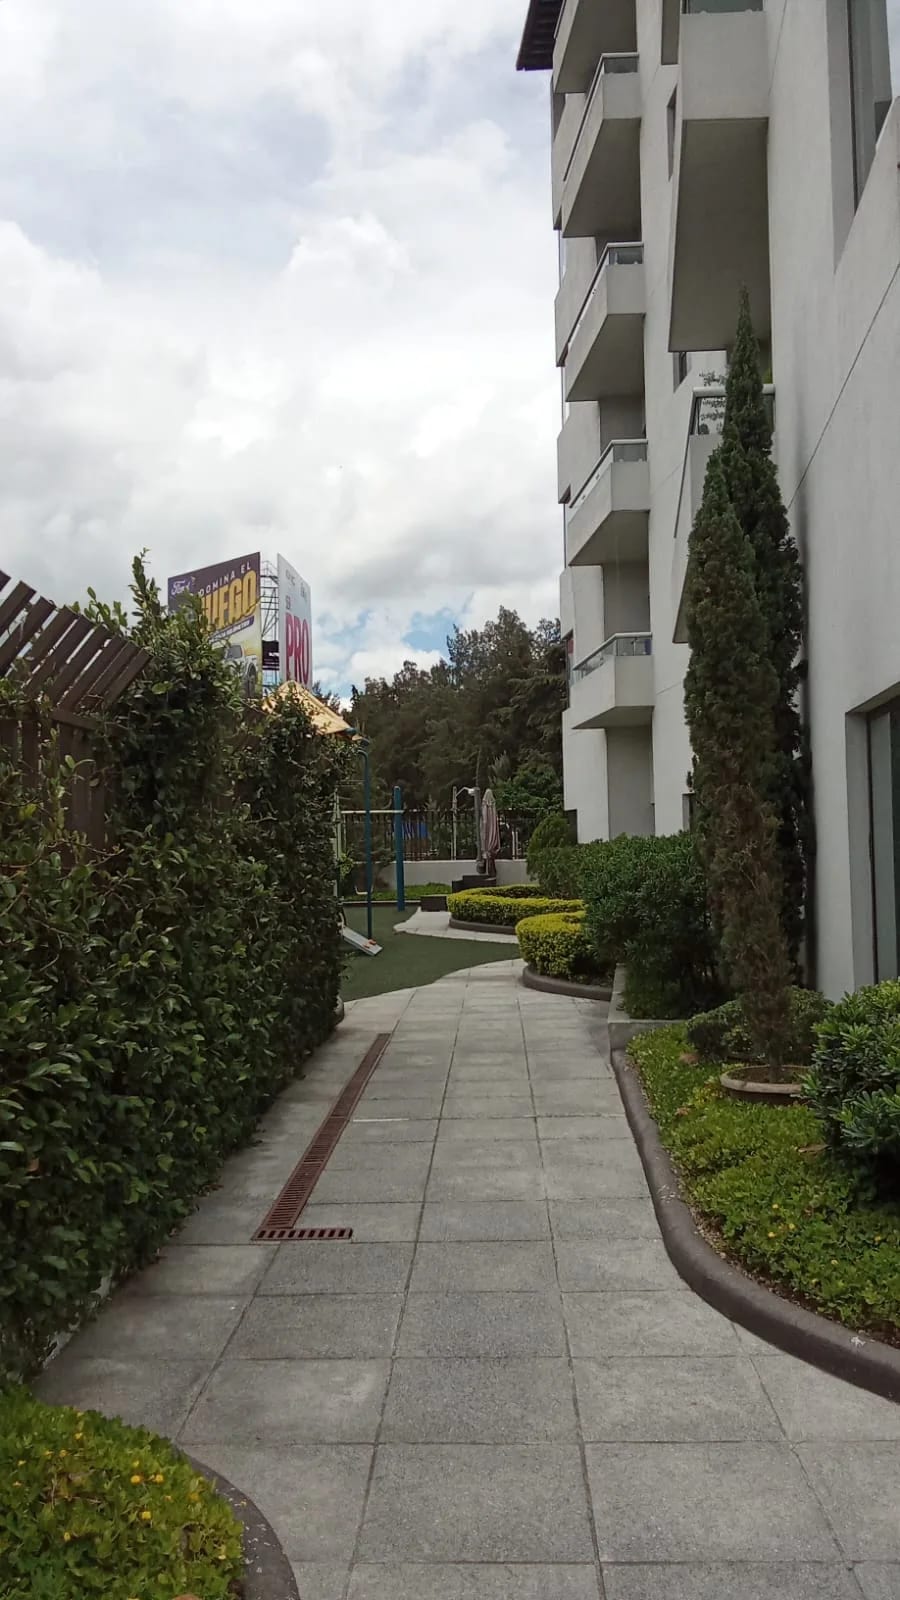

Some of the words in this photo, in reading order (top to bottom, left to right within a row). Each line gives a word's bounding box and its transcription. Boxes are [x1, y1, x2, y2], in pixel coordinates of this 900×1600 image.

[200, 570, 236, 598] DOMINA
[241, 561, 251, 574] EL
[285, 612, 310, 685] PRO
